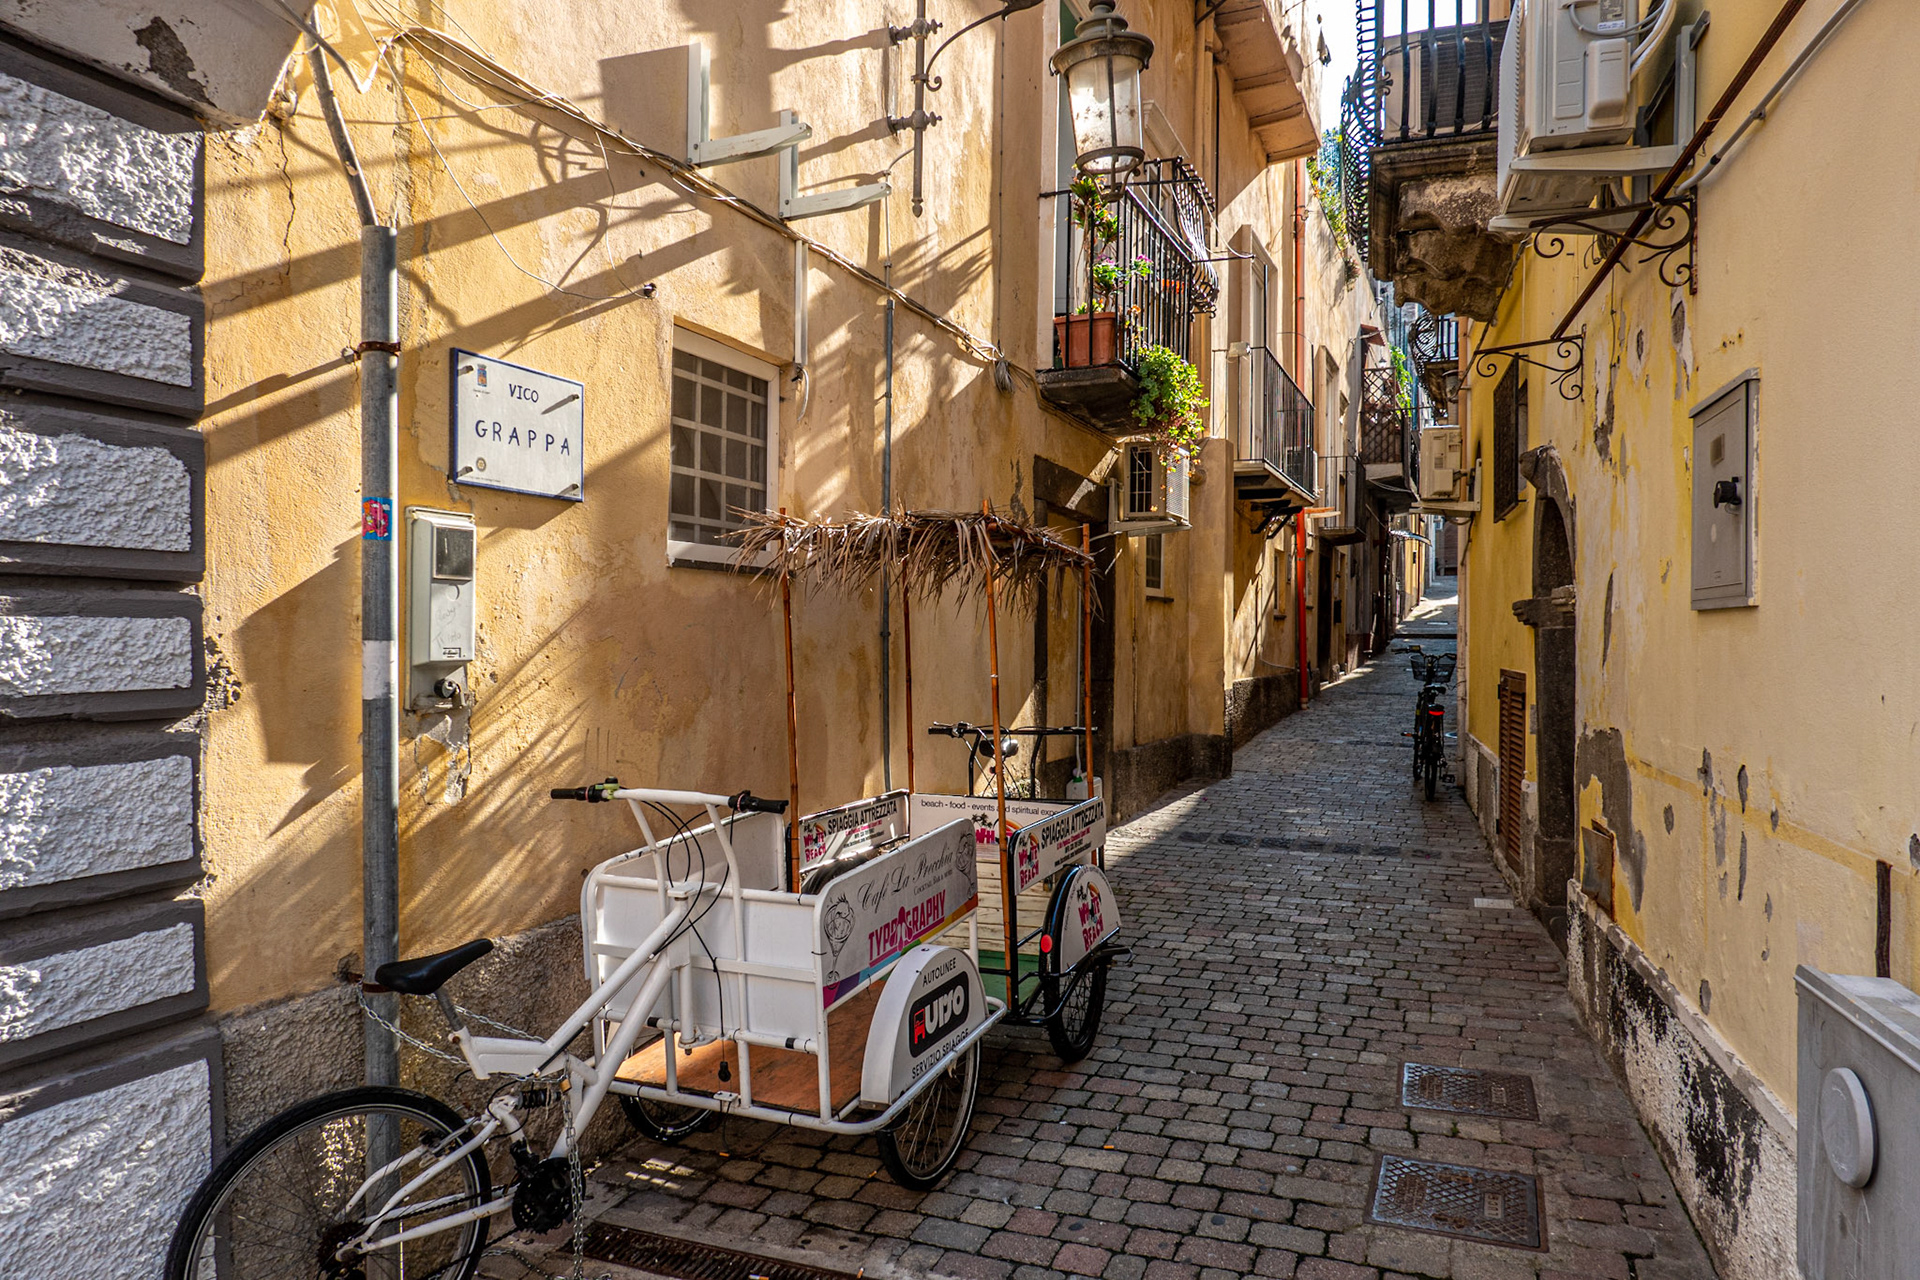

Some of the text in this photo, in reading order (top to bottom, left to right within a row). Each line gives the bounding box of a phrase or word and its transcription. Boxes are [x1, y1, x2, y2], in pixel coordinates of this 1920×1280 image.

[509, 383, 539, 403] VICO
[475, 420, 570, 456] GRAPPA
[828, 815, 859, 835] SPIAGGIA
[860, 800, 897, 824] ATTREZZATA
[921, 800, 943, 808] beach
[950, 801, 966, 810] food
[972, 804, 995, 812] events
[1012, 807, 1039, 815] spiritual
[1041, 818, 1071, 850] SPIAGGIA
[1071, 801, 1104, 833] ATTREZZATA
[804, 844, 826, 863] BEACH
[891, 863, 910, 895] La
[1020, 860, 1039, 890] BEACH
[869, 889, 946, 963] TYPOGRAPHY
[1082, 914, 1104, 952] BEACH
[923, 958, 957, 988] AUTOLINEE
[912, 1049, 941, 1079] SERVIZIO
